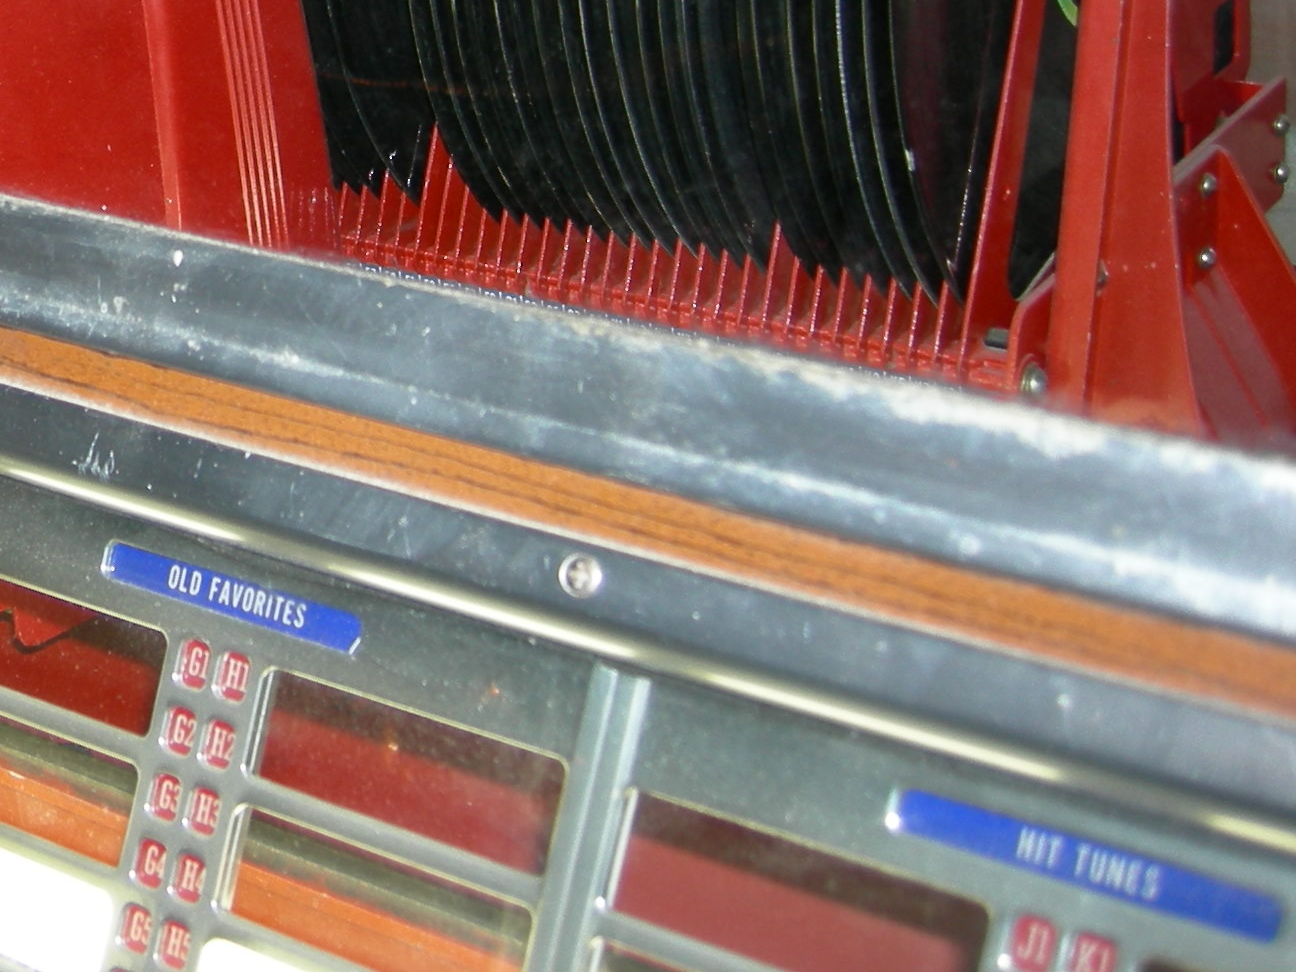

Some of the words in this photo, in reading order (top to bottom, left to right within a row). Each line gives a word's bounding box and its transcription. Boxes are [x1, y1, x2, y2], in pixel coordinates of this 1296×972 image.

[168, 564, 202, 596] OLD
[208, 576, 307, 628] FAVORITES
[188, 647, 210, 682] G1
[226, 659, 249, 692] H1
[173, 713, 197, 747] G2
[212, 726, 236, 762] H2
[1016, 825, 1064, 869] HIT
[1074, 842, 1161, 901] TUNES
[1016, 922, 1049, 966] J1
